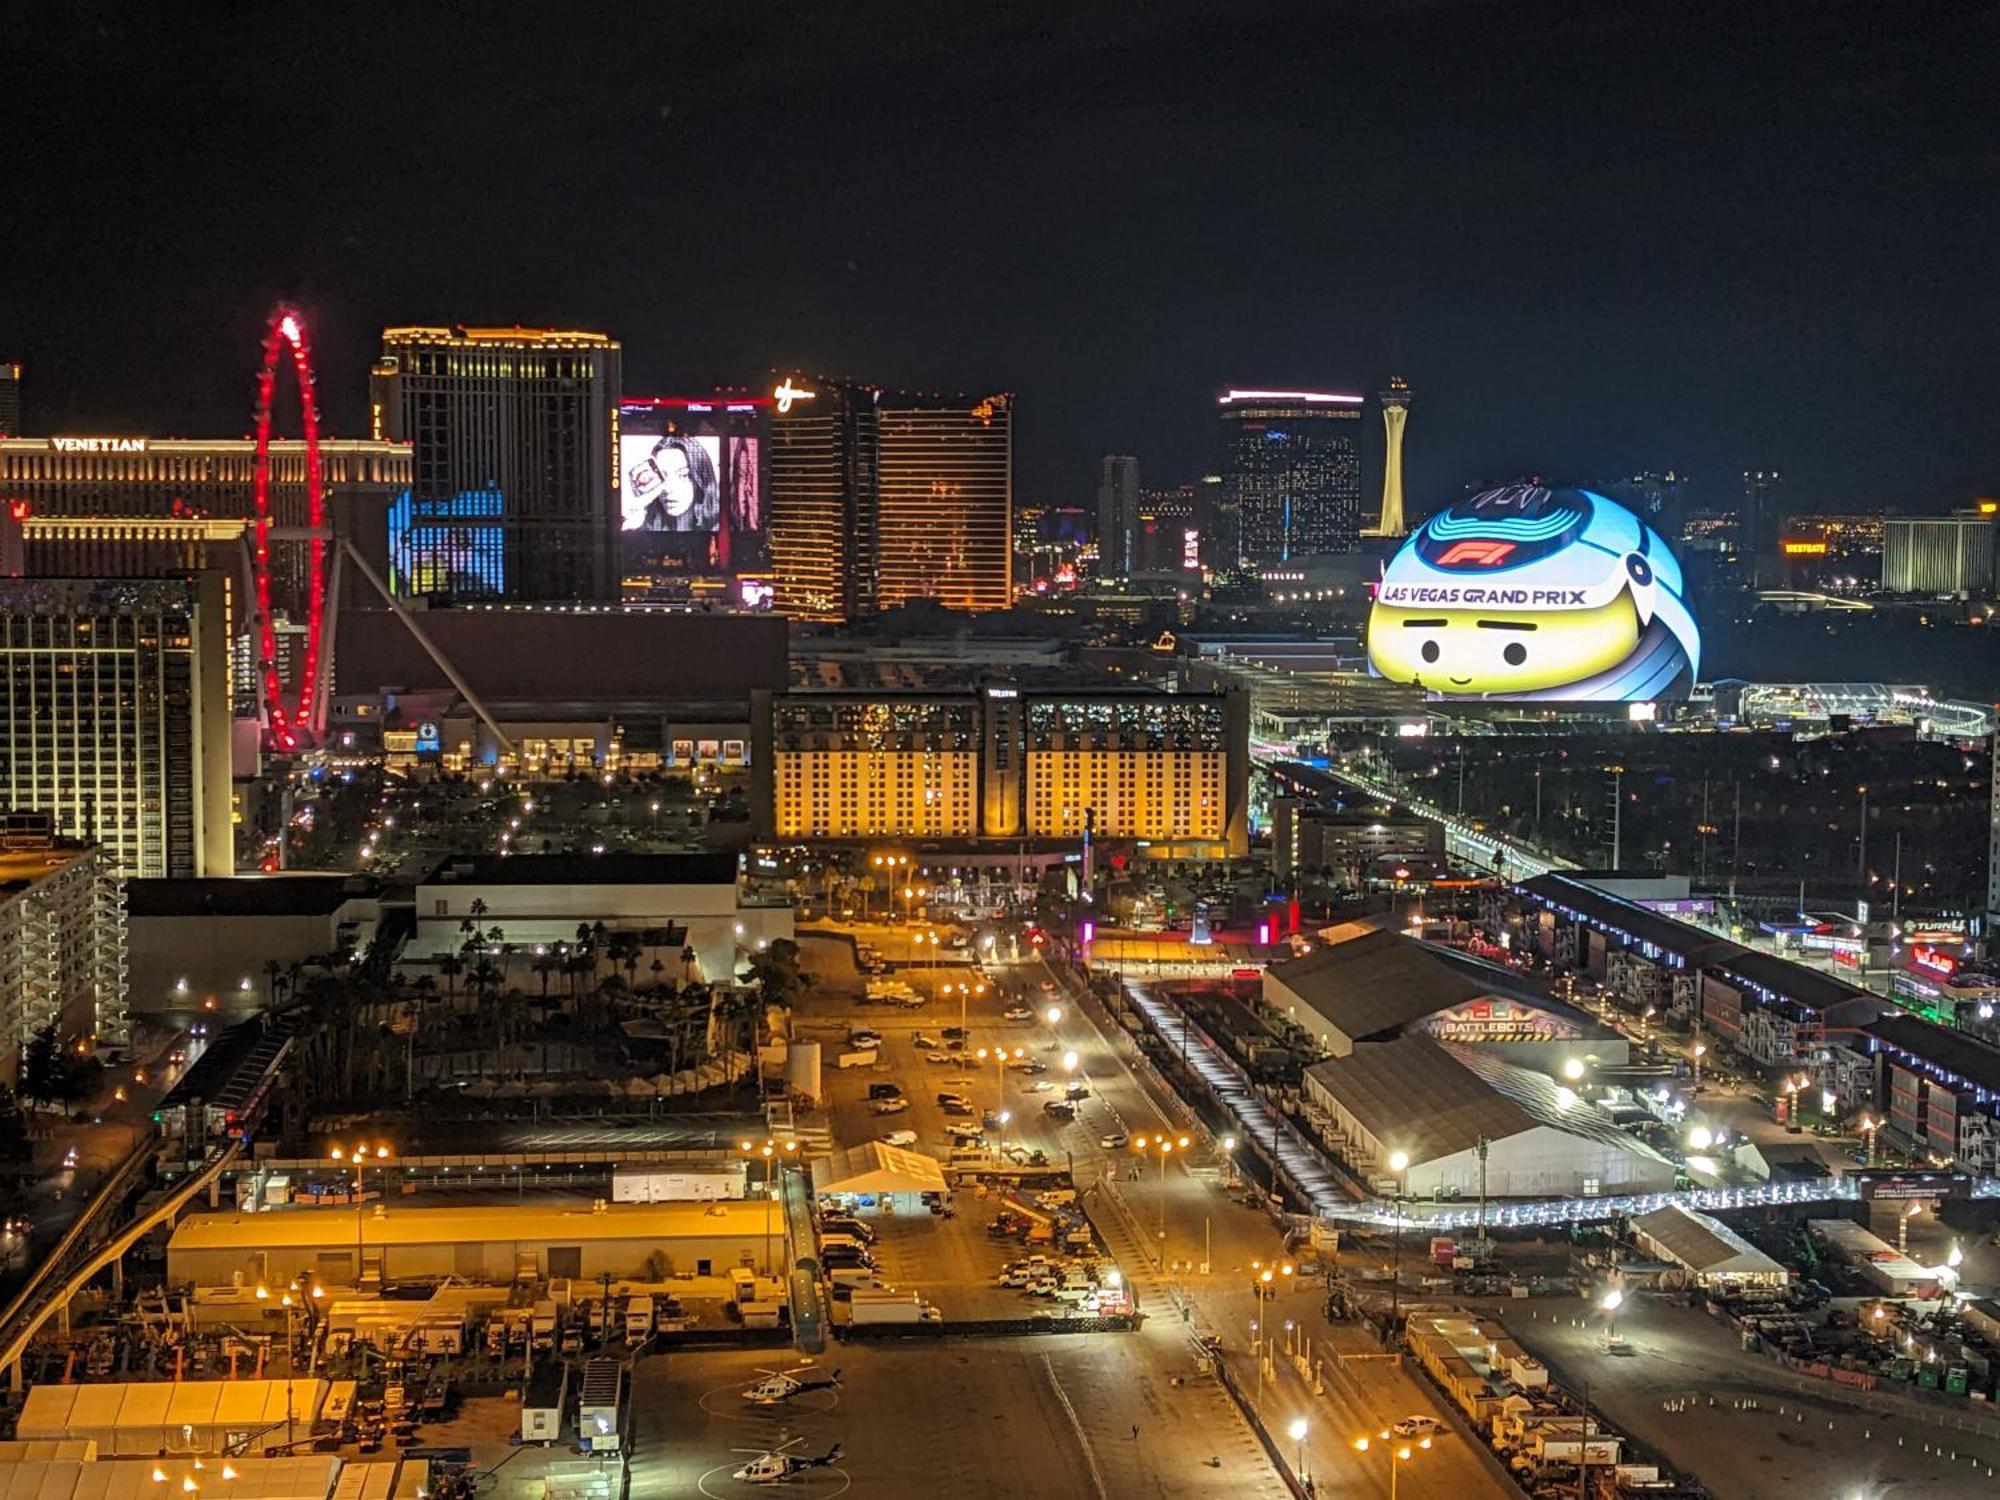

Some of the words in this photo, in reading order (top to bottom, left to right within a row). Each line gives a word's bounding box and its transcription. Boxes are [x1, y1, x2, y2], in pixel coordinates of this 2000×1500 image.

[52, 438, 145, 452] VENETIAN
[611, 408, 619, 489] PALAZZO
[1384, 586, 1408, 601] LAS
[1411, 588, 1460, 602] VEGAS
[1463, 589, 1528, 604] GRAND
[1532, 590, 1587, 605] PRIX
[1446, 1023, 1534, 1033] BATTLEBOTS
